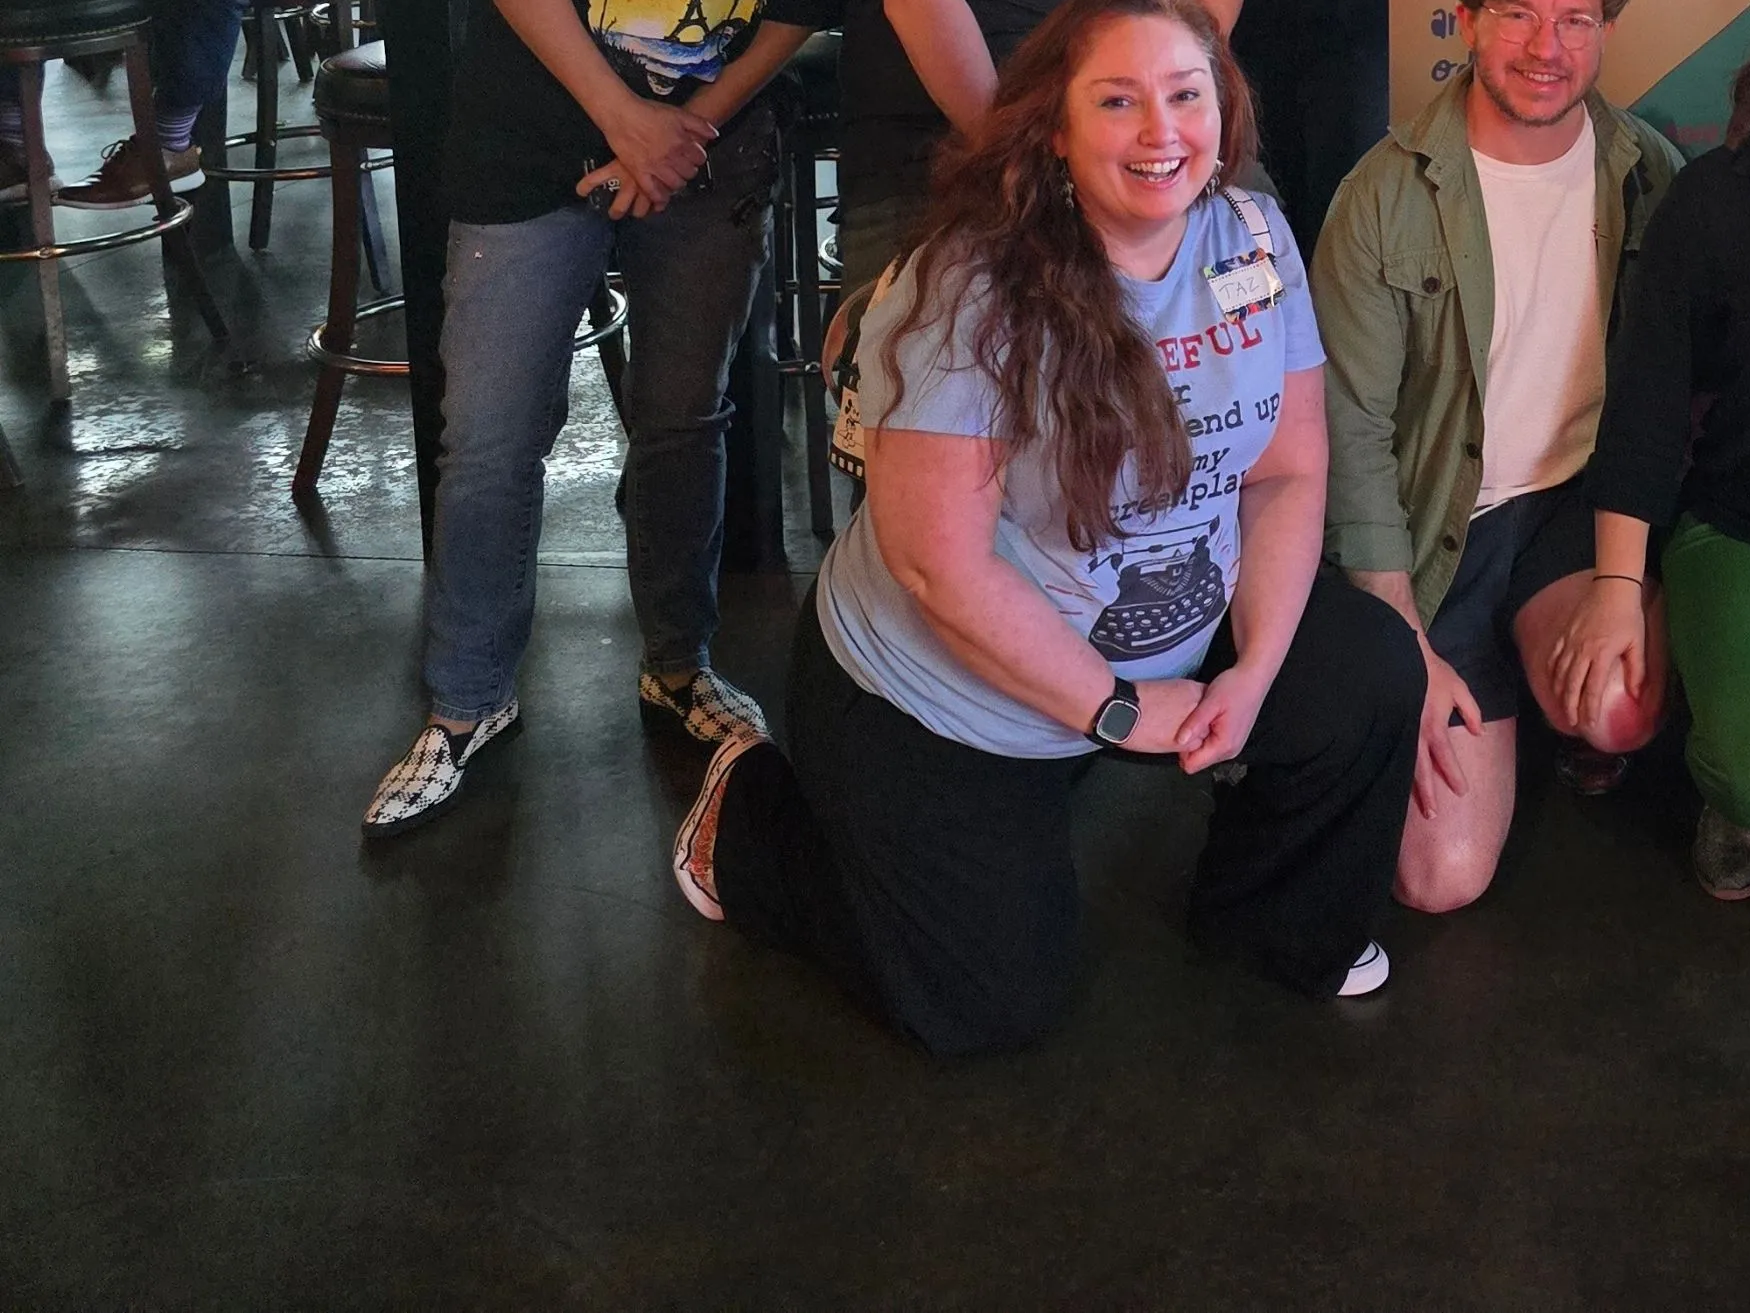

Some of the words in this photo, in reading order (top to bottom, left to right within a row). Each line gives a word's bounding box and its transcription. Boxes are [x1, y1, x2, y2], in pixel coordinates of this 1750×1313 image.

[1219, 278, 1261, 299] TAZ
[1155, 318, 1263, 373] EFUL
[1254, 392, 1281, 423] up
